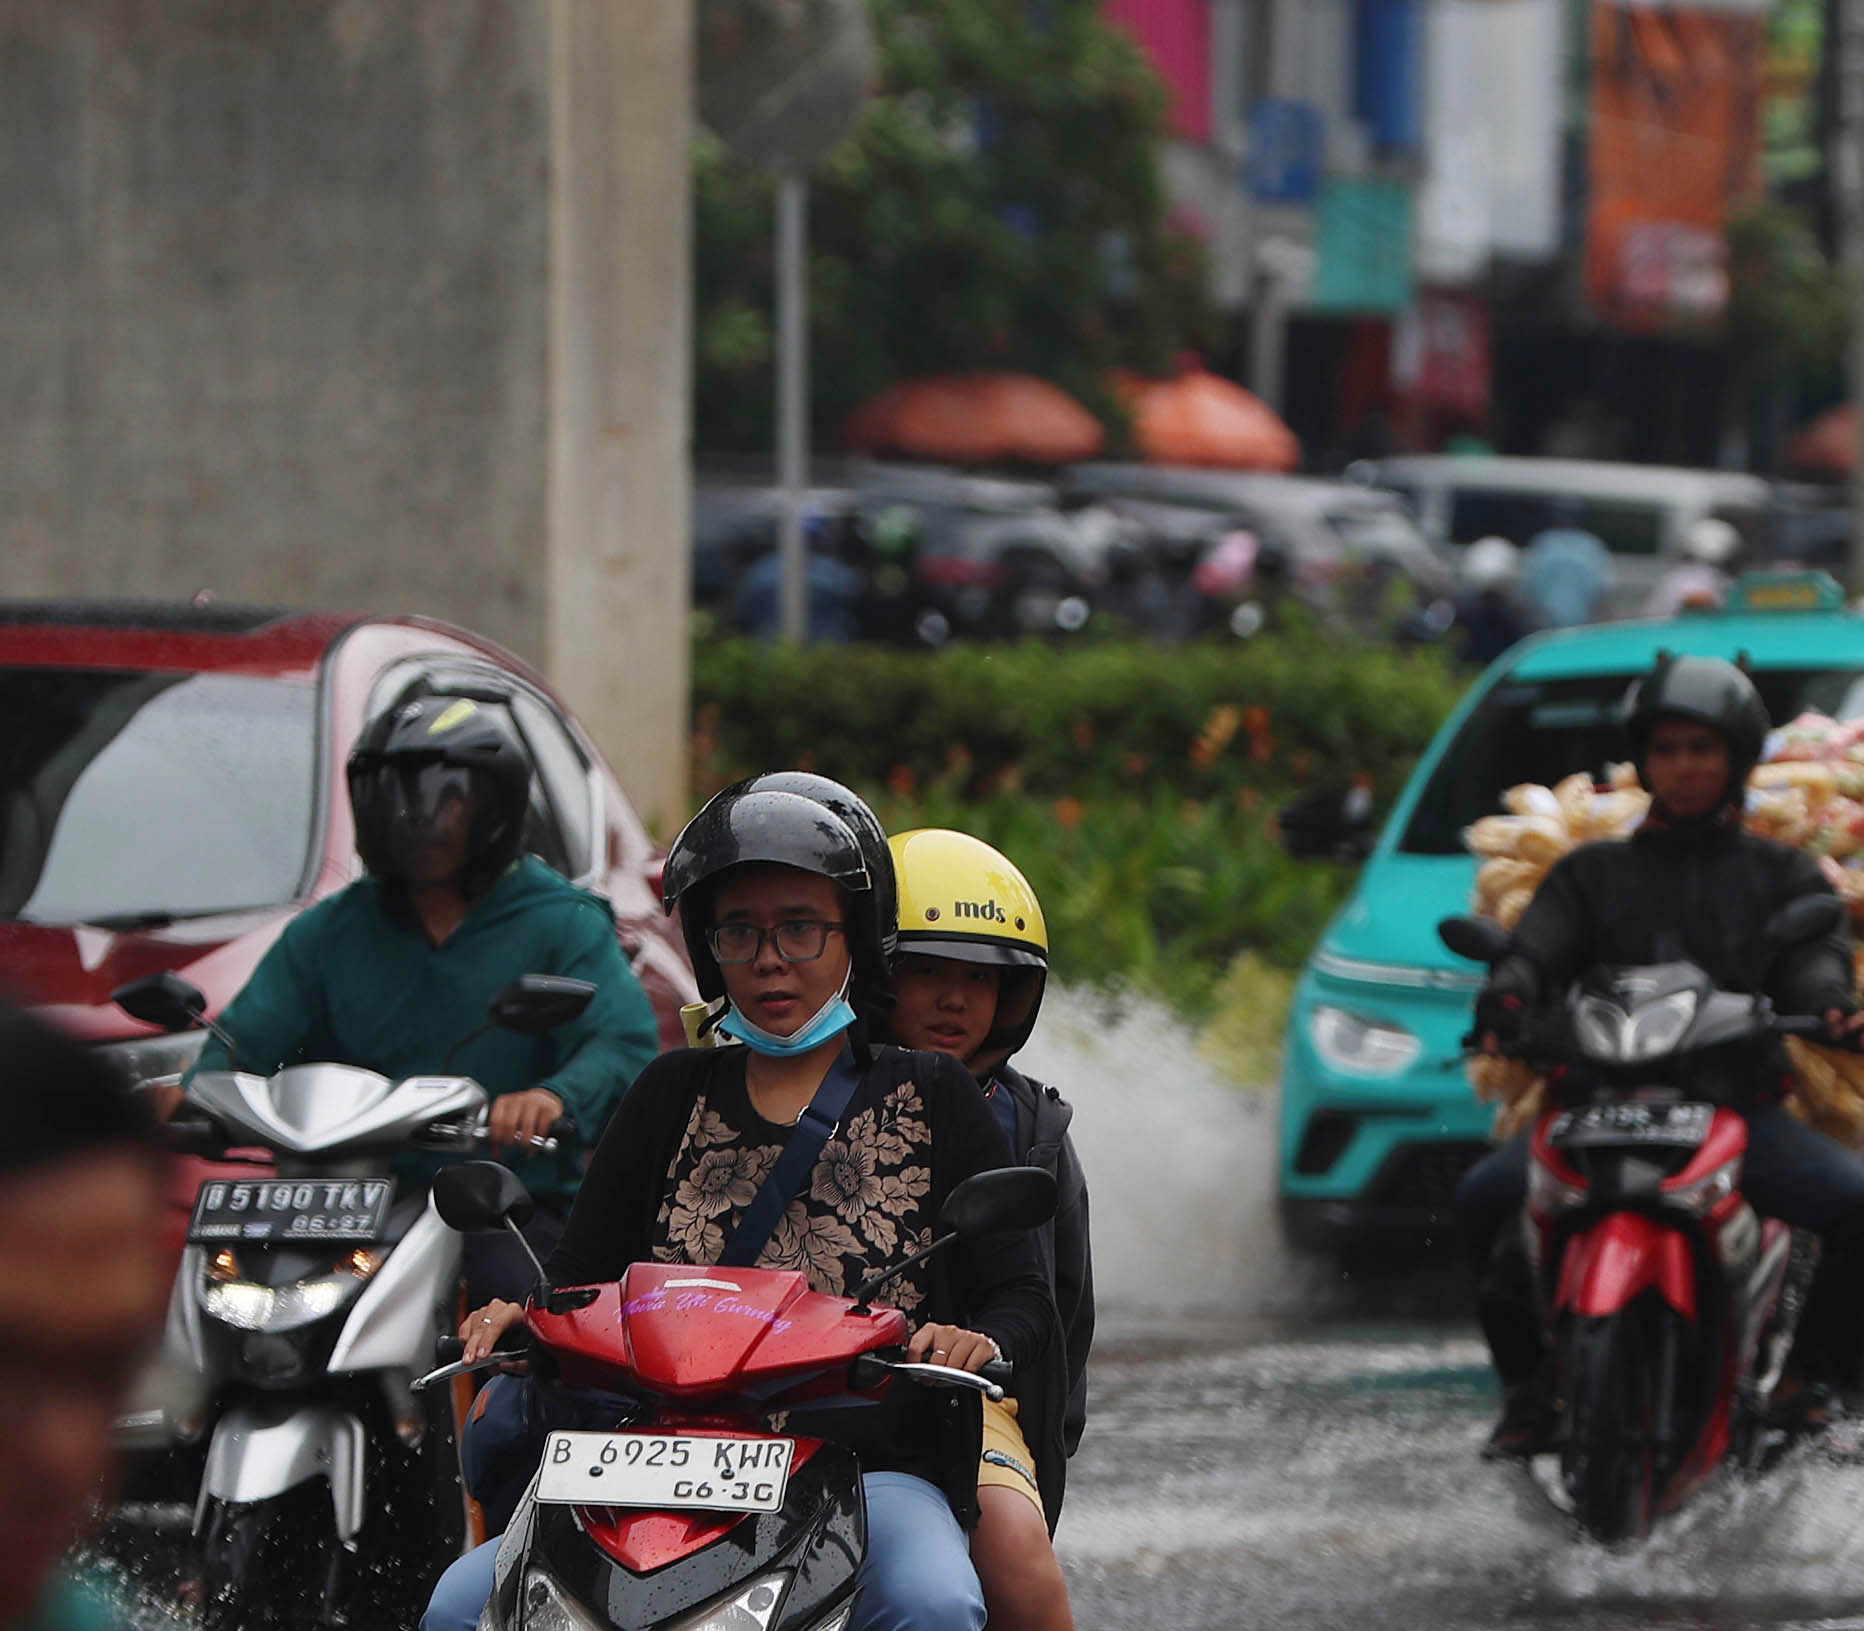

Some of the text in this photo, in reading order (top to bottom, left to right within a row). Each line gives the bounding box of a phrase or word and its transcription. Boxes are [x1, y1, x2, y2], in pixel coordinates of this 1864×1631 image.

[955, 900, 1006, 923] mds
[230, 1184, 314, 1211] 5190
[324, 1183, 383, 1210] TKV
[552, 1439, 786, 1469] B 6925 KWR
